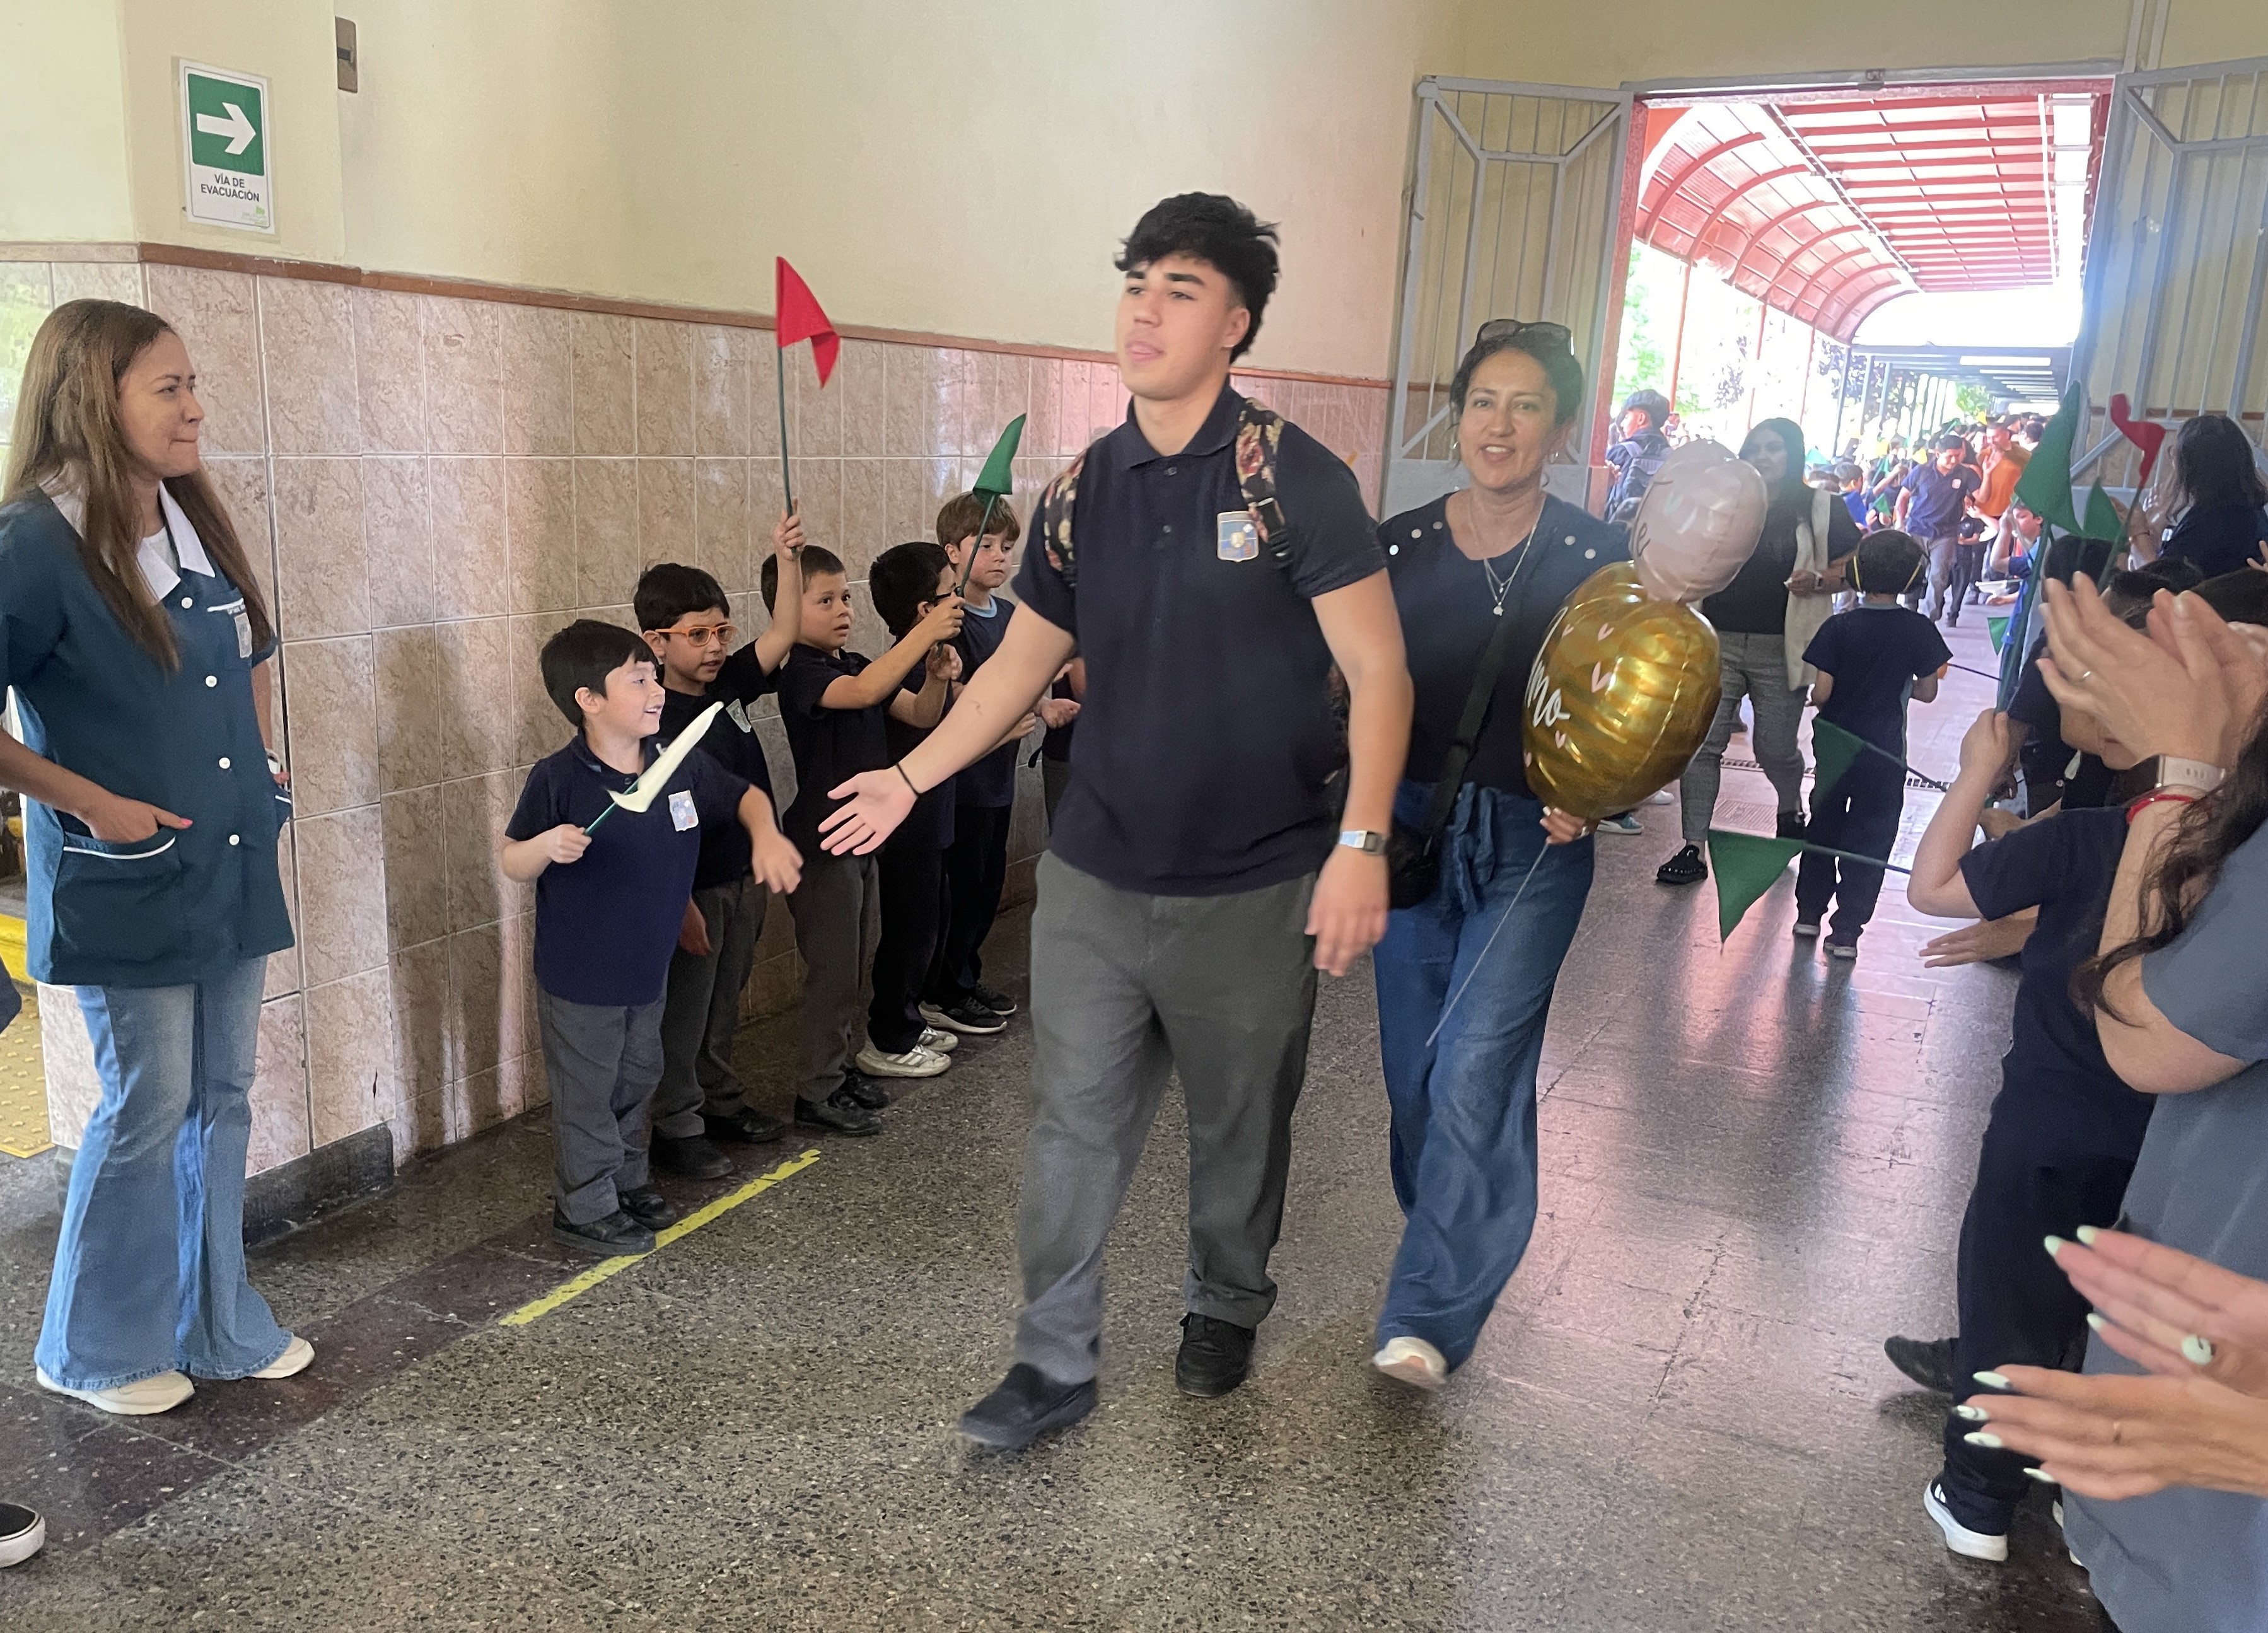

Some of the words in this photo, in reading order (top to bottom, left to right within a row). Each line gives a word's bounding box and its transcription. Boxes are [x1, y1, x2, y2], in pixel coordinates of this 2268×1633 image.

[214, 173, 230, 185] VÍA
[232, 177, 245, 188] DE
[201, 183, 260, 202] EVACUACIÓN
